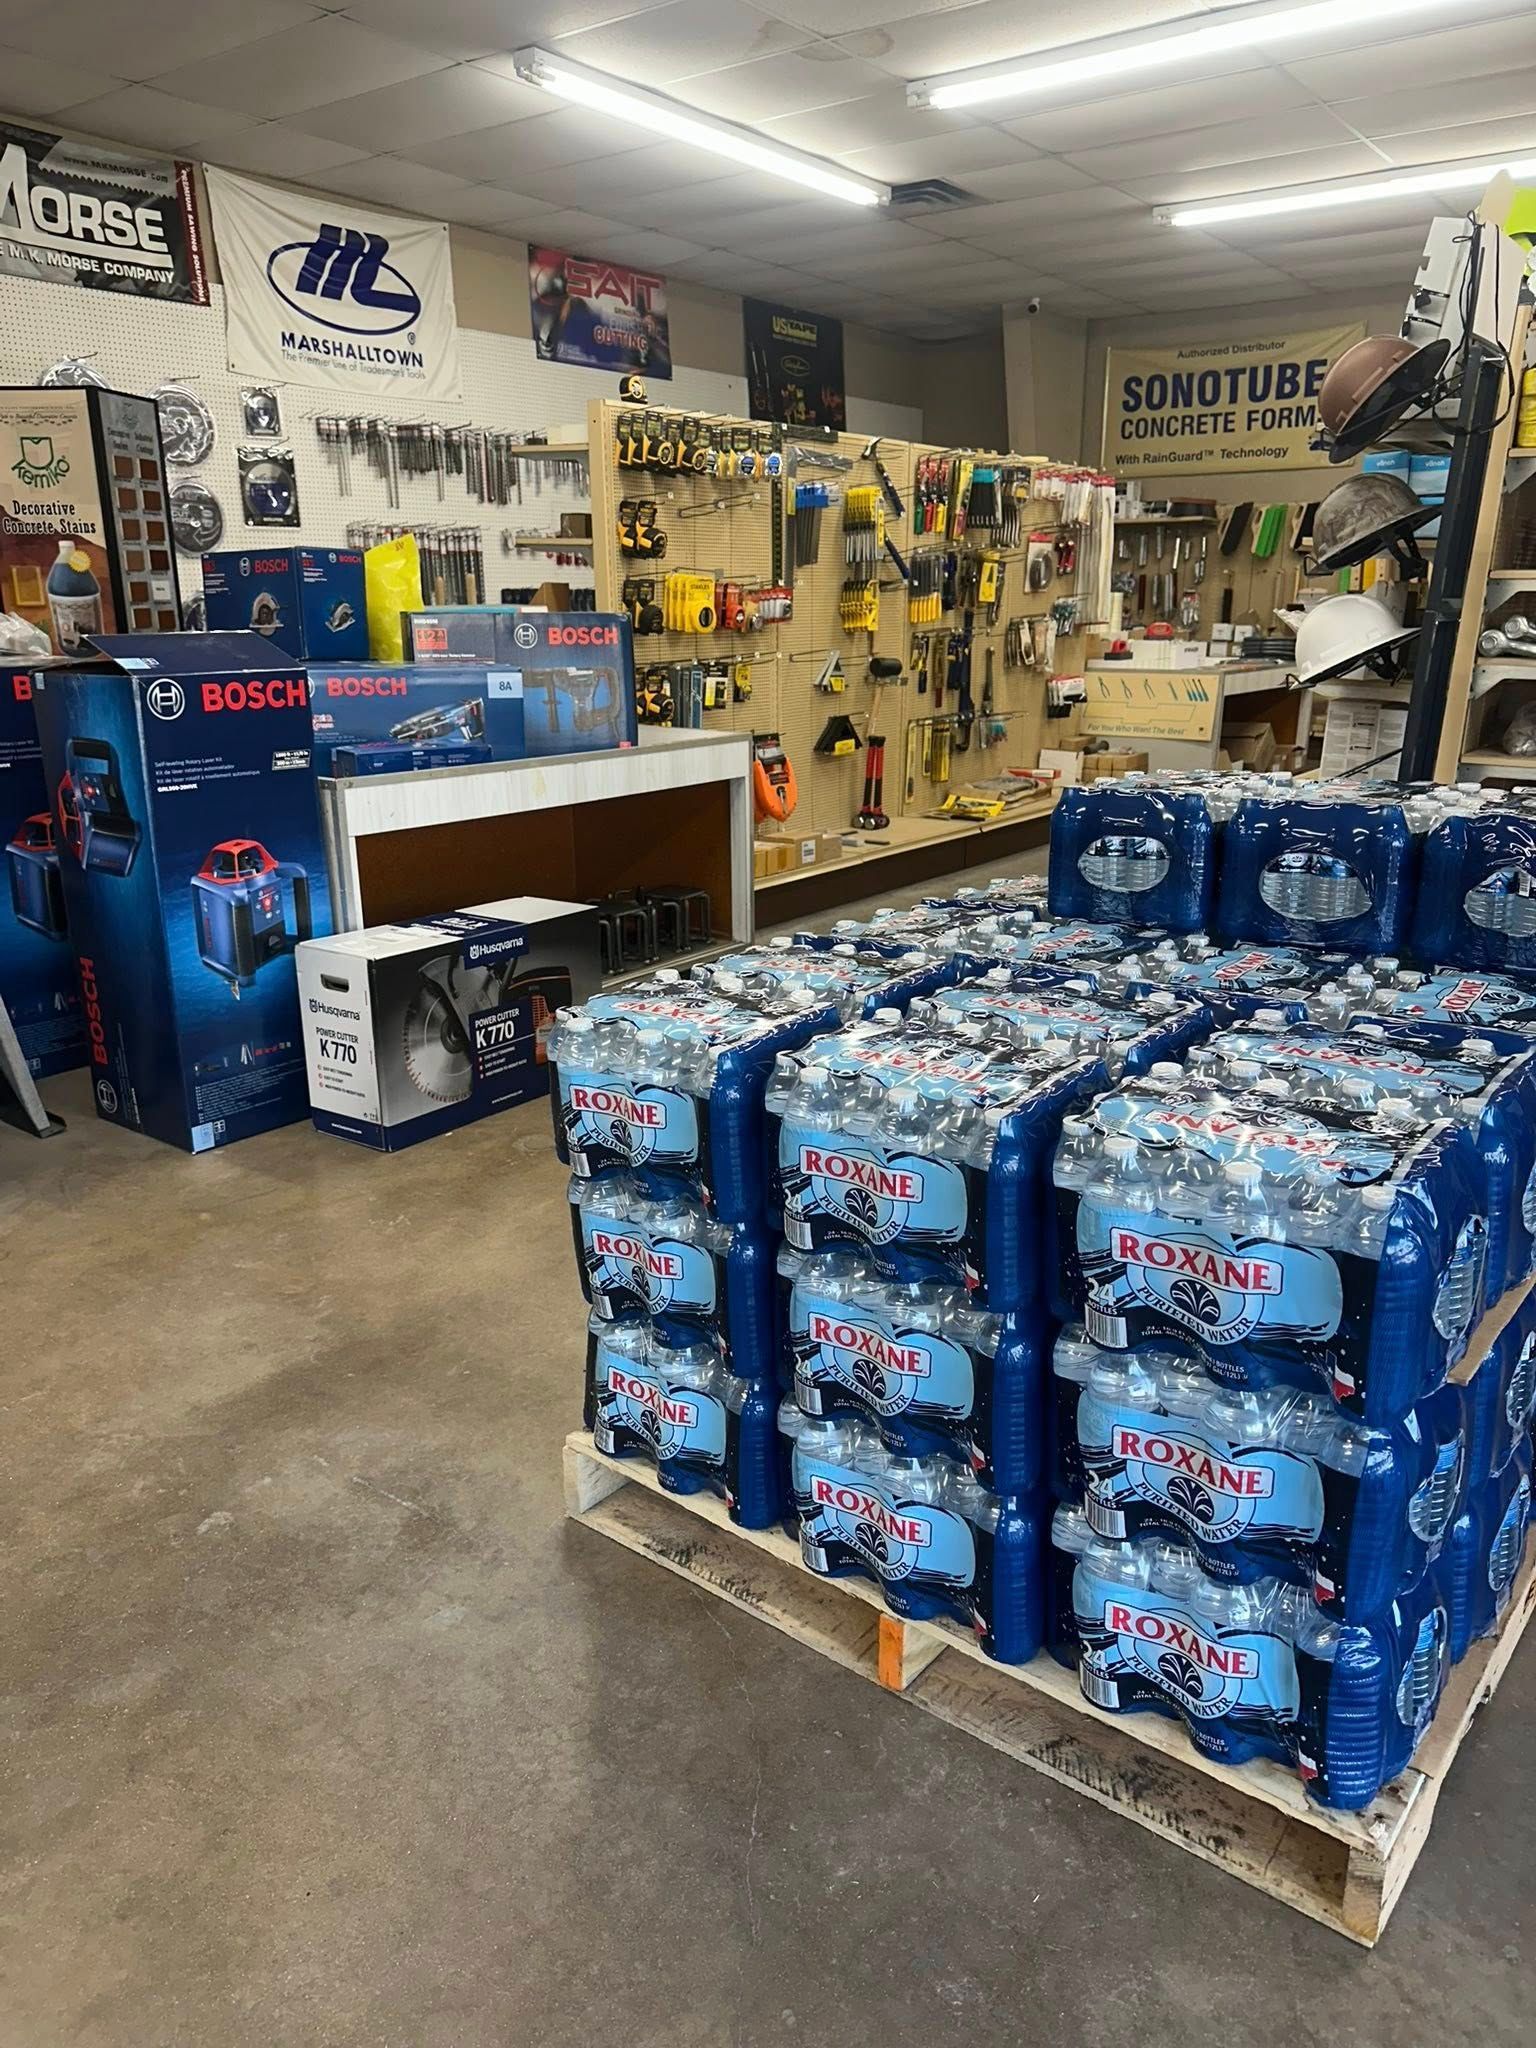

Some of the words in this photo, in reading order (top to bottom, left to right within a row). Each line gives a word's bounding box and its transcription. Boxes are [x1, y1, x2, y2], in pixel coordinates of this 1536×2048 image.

[9, 246, 44, 265] M.K.
[48, 250, 101, 273] MORSE
[103, 261, 176, 285] COMPANY
[564, 257, 663, 312] SAIT
[281, 331, 424, 368] MARSHALLTOWN
[594, 326, 649, 350] CUTTING
[1177, 346, 1230, 360] Authorized
[1232, 341, 1286, 355] Distributor
[281, 349, 297, 362] The
[350, 362, 358, 372] of
[406, 368, 426, 380] Tools
[1121, 358, 1328, 413] SONOTUBE
[1120, 411, 1236, 440] CONCRETE
[1246, 405, 1322, 432] FORM
[1115, 454, 1141, 465] With
[1220, 446, 1289, 461] Technology
[12, 499, 76, 516] Decorative
[3, 518, 55, 535] Concrete
[59, 518, 97, 535] Stains
[254, 558, 289, 574] BOSCH
[547, 627, 619, 646] BOSCH
[202, 680, 307, 713] BOSCH
[327, 677, 408, 697] BOSCH
[498, 680, 513, 692] 8A
[1115, 724, 1131, 732] Who
[1152, 726, 1166, 734] The
[1167, 727, 1185, 735] Best
[479, 937, 524, 957] Husqvarna
[79, 957, 108, 1065] BOSCH
[318, 1002, 361, 1021] Husqvarna
[475, 1013, 497, 1028] POWER
[497, 1008, 520, 1022] CUTTER
[616, 1001, 722, 1025] ROXANE
[980, 998, 1101, 1022] ROXANE
[315, 1026, 337, 1039] POWER
[336, 1031, 359, 1044] CUTTER
[475, 1030, 487, 1049] K
[488, 1020, 515, 1044] 770
[319, 1038, 330, 1059] K
[330, 1041, 357, 1065] 770
[1271, 1043, 1426, 1076] ROXANE
[574, 1088, 661, 1126] ROXANE
[590, 1127, 629, 1155] PURIF
[805, 1149, 916, 1198] ROXANE
[819, 1195, 870, 1235] PURIFIED
[1118, 1233, 1272, 1291] ROXANE
[1087, 1276, 1117, 1306] 24
[1088, 1300, 1118, 1316] BOTTLES
[1136, 1285, 1205, 1336] PURIFIED
[1207, 1316, 1255, 1344] WATER
[814, 1317, 924, 1374] ROXANE
[1215, 1360, 1245, 1374] BOTTLES
[1120, 1431, 1264, 1496] ROXANE
[1088, 1469, 1116, 1500] 24
[799, 1512, 817, 1539] 4
[817, 1480, 924, 1544] ROXANE
[1134, 1481, 1201, 1532] PURIFIED
[1201, 1519, 1246, 1541] WATER
[1112, 1606, 1251, 1676] ROXANE
[1126, 1655, 1191, 1707] PURIFIED
[1191, 1697, 1235, 1718] WATER
